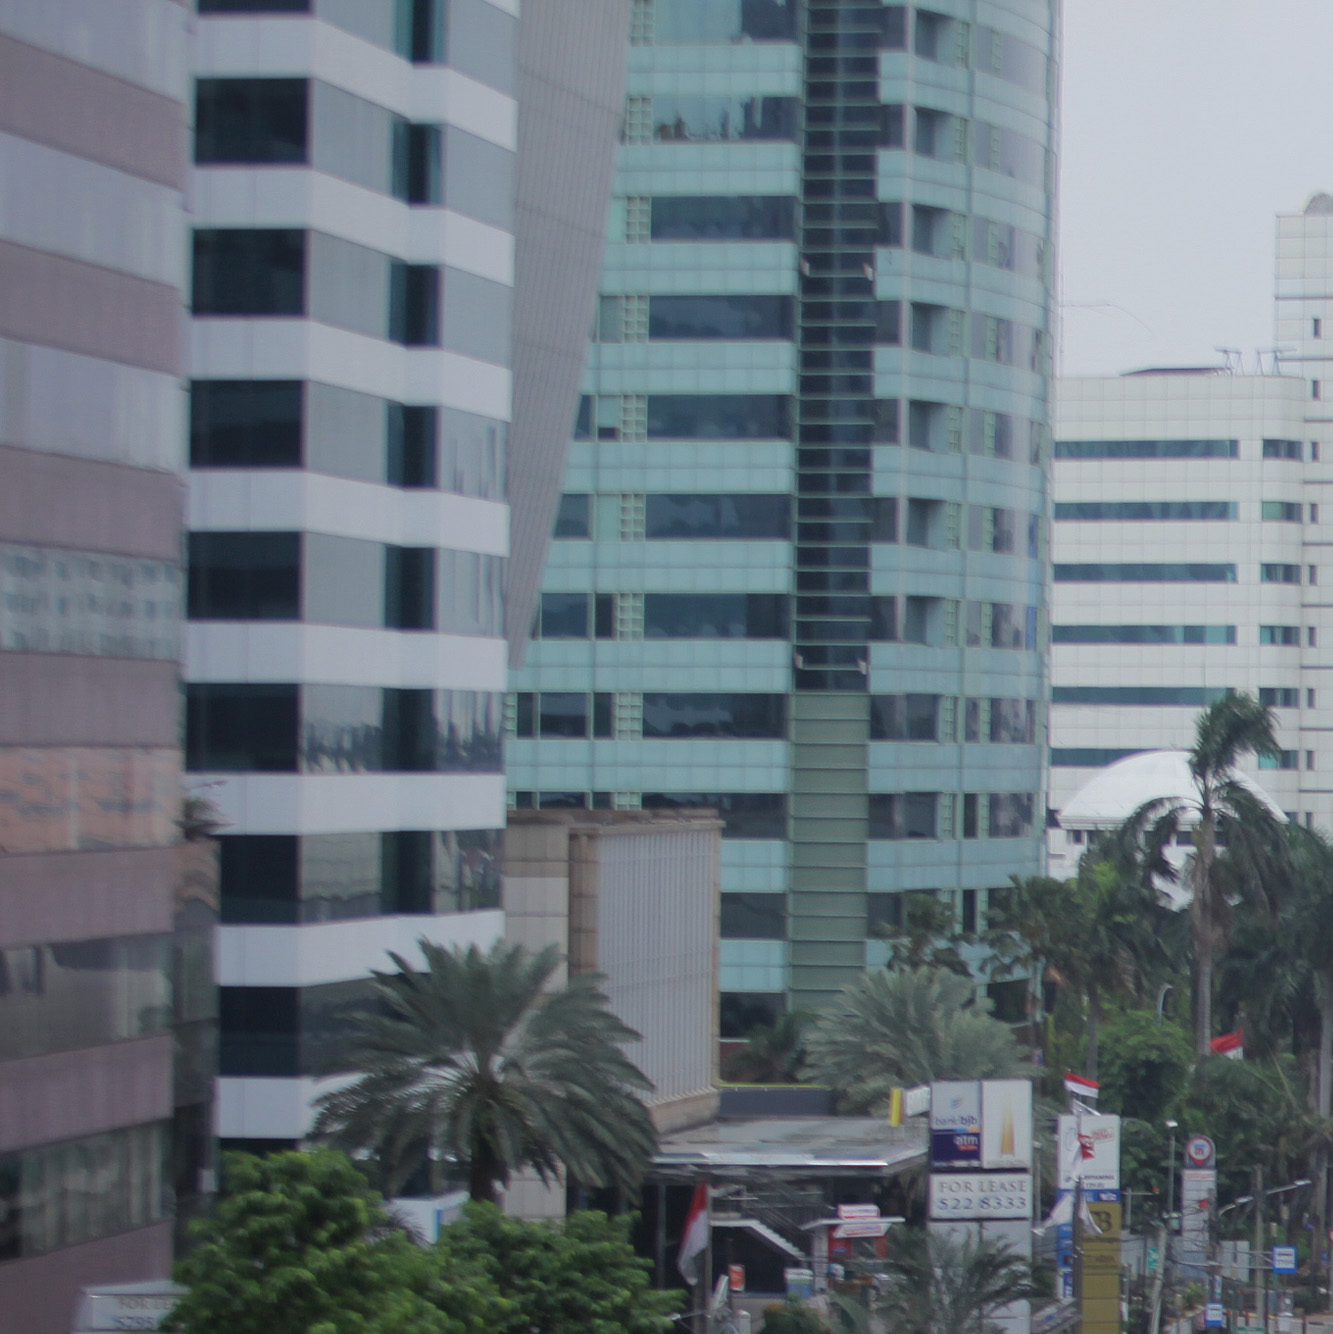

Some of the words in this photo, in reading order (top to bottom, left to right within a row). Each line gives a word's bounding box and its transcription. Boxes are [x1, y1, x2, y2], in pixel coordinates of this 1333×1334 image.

[955, 1135, 978, 1145] atm
[940, 1181, 974, 1193] FOR
[979, 1181, 1027, 1193] LEASE
[937, 1197, 973, 1210] 522
[979, 1197, 1027, 1210] 8333
